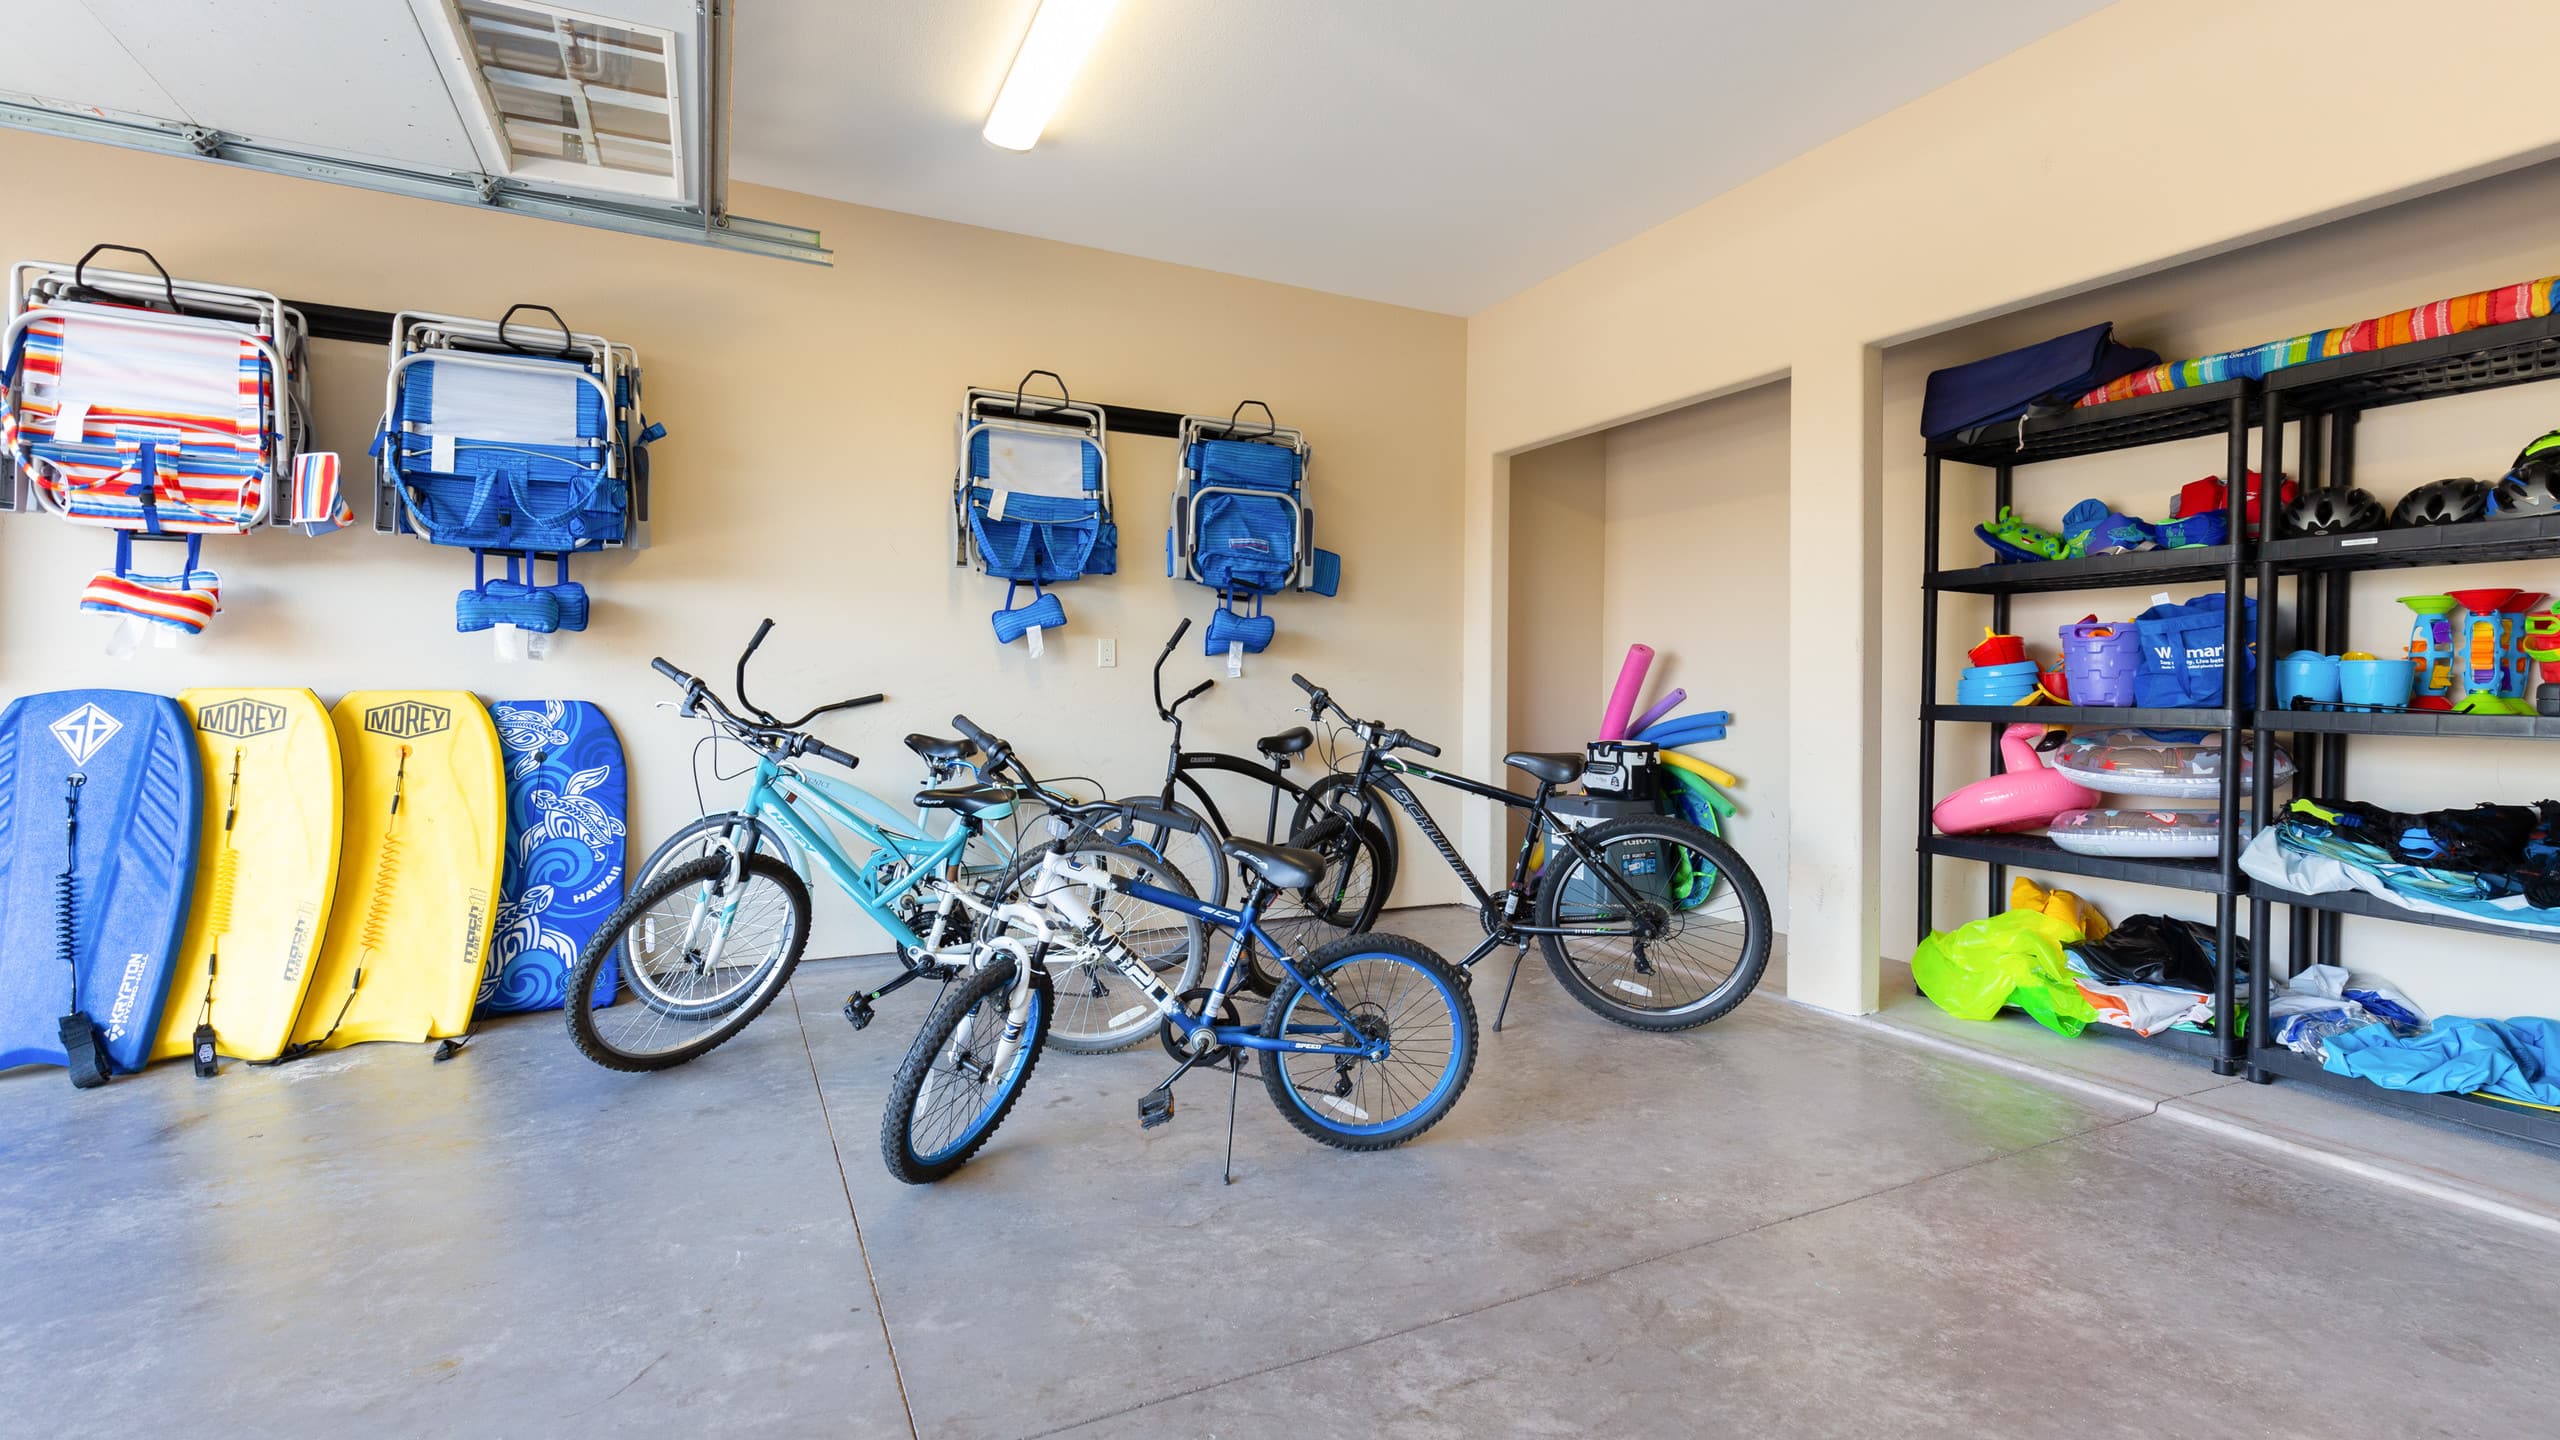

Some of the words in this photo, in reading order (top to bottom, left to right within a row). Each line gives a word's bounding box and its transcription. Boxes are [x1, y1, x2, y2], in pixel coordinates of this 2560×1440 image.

[2154, 644, 2225, 659] Wmar
[204, 701, 282, 735] MOREY
[370, 704, 447, 735] MOREY
[572, 865, 622, 904] HAWAII
[109, 953, 144, 1024] KRYPTON
